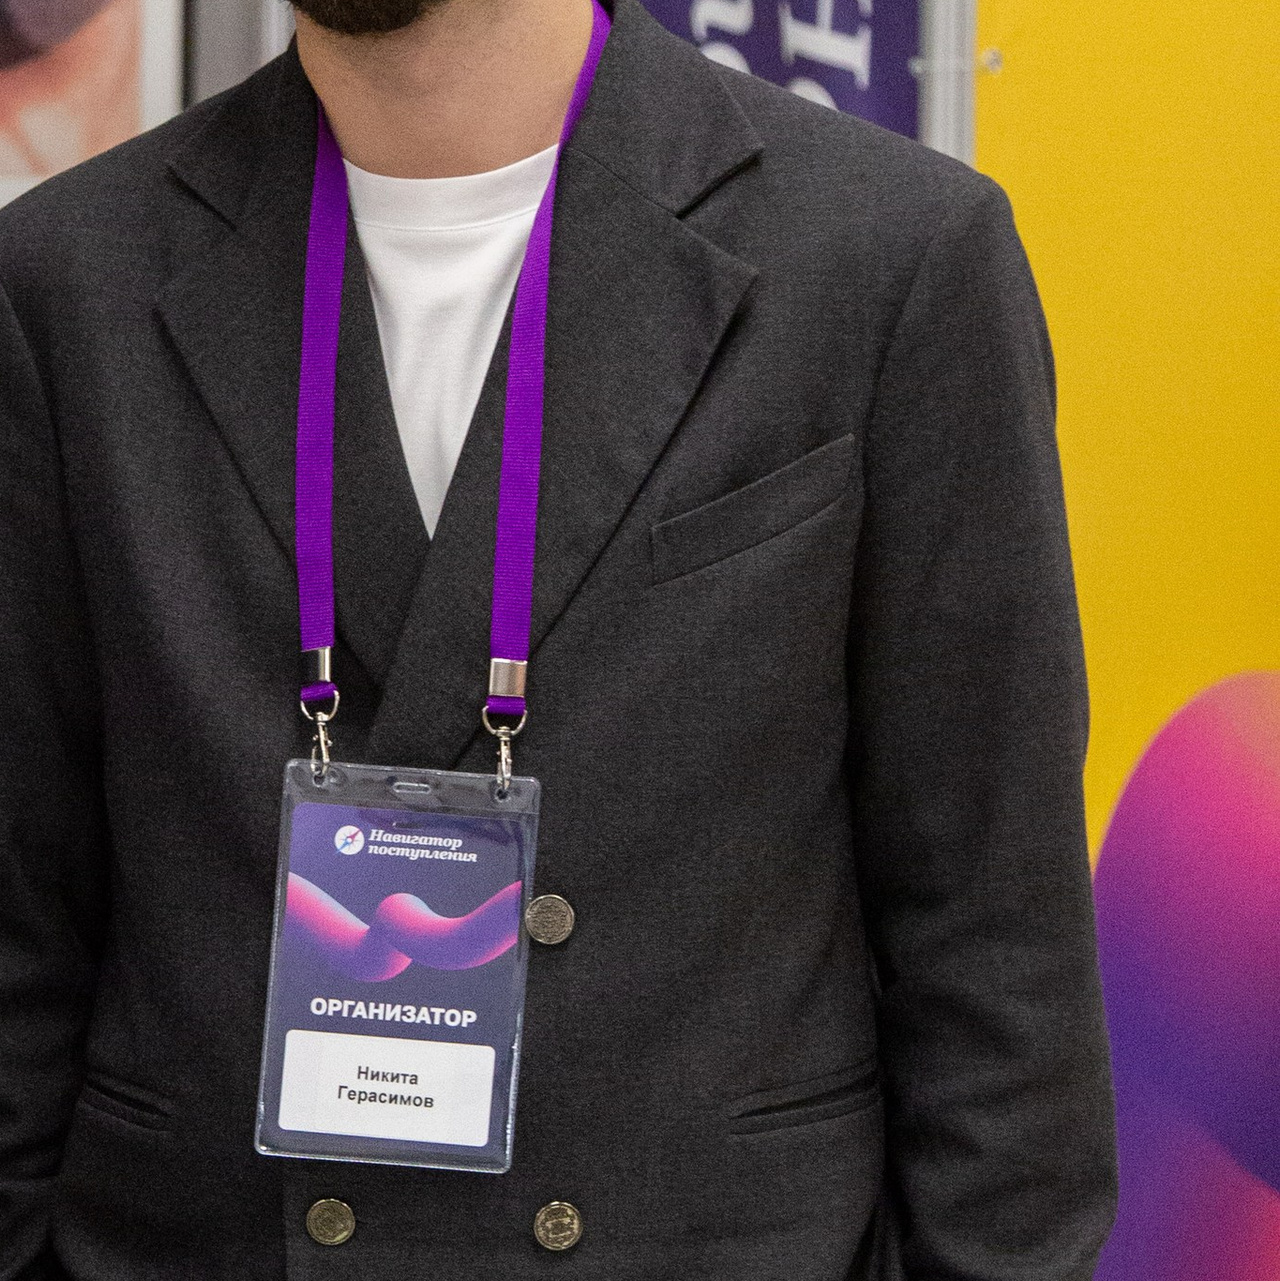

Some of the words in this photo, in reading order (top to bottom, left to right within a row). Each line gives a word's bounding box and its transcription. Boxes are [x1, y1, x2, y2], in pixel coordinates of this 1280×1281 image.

[368, 828, 463, 850] Навигатор
[367, 844, 478, 863] поступления
[309, 997, 478, 1028] ОРГАНИЗАТОР
[356, 1065, 419, 1085] Никита
[337, 1085, 435, 1109] Герасимов
